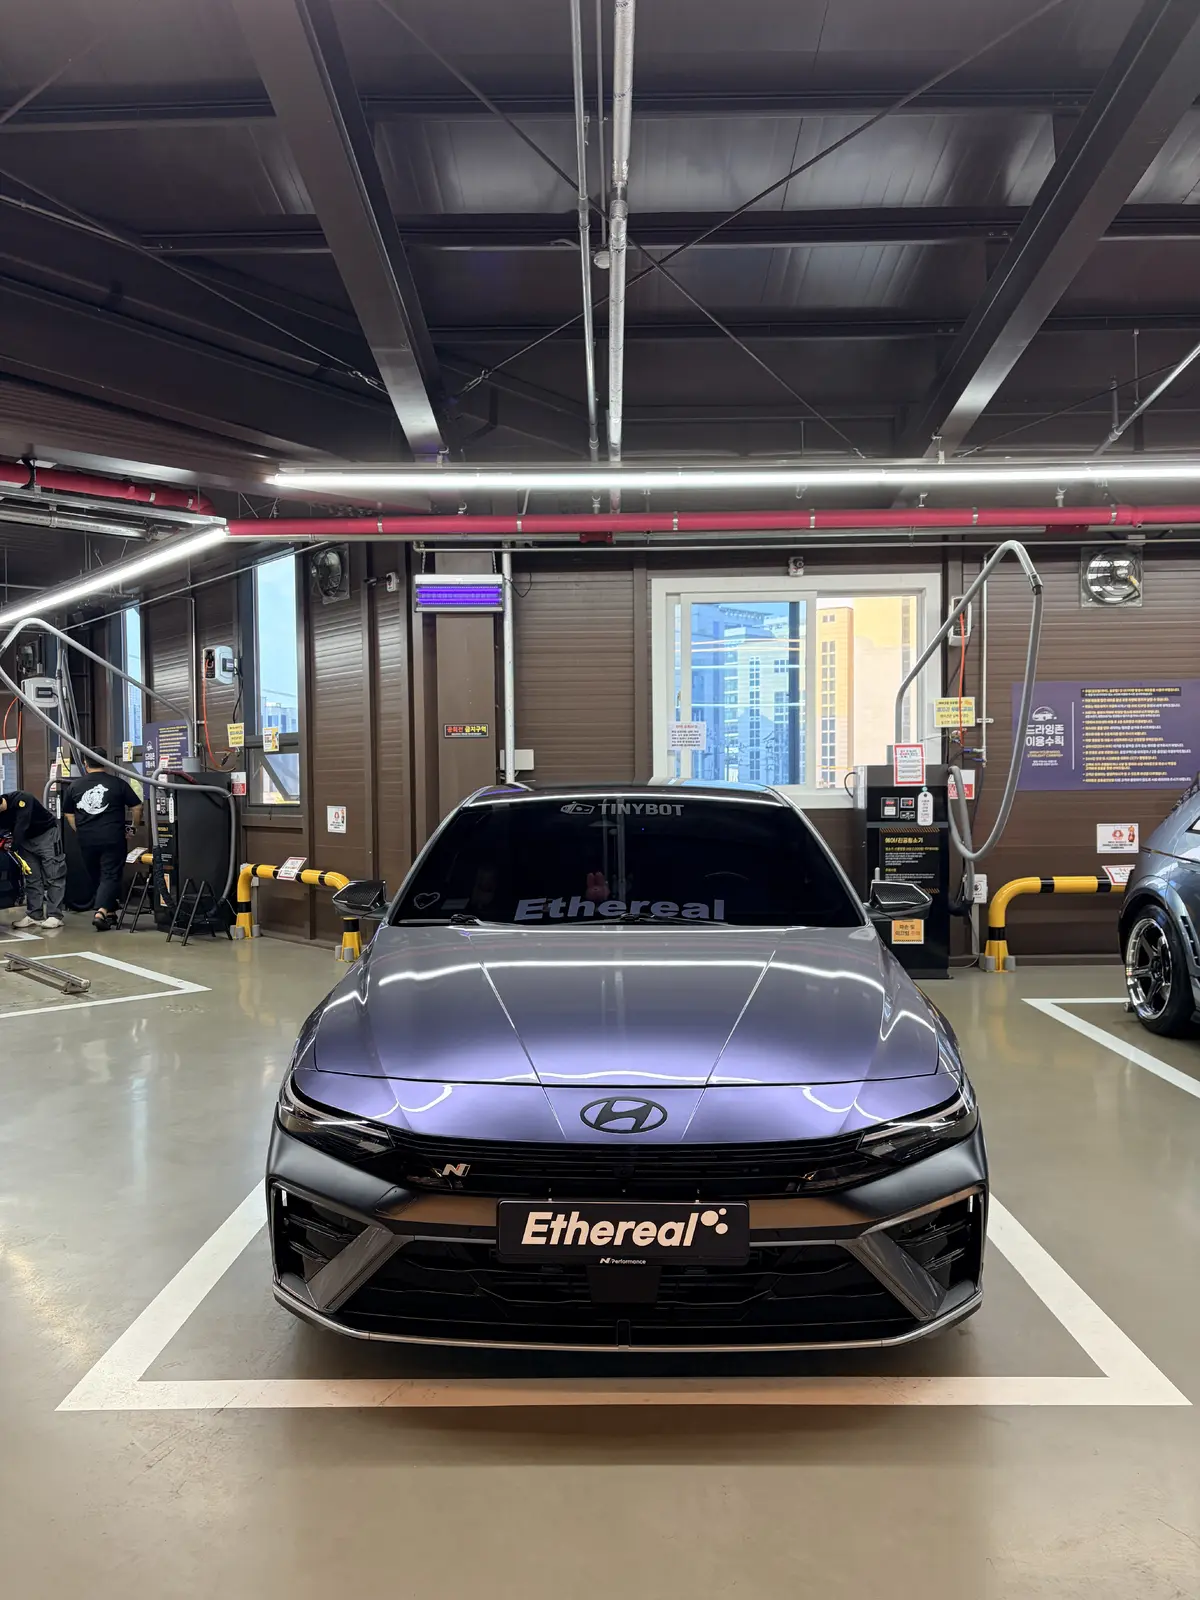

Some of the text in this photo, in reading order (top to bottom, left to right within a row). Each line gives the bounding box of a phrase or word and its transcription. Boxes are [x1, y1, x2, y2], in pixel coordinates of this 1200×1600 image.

[1025, 724, 1065, 735] 드라잉존
[598, 803, 684, 816] TINYBOT
[514, 896, 725, 921] Ethereal
[521, 1210, 699, 1247] Ethereal
